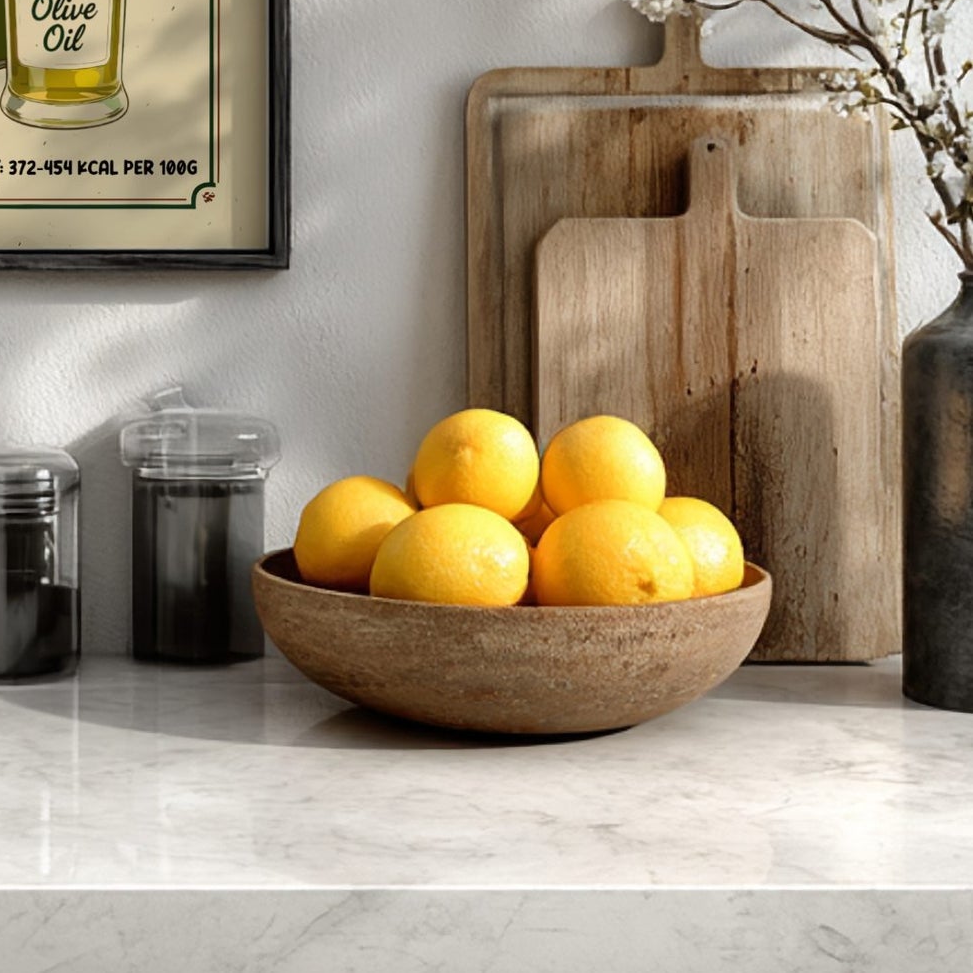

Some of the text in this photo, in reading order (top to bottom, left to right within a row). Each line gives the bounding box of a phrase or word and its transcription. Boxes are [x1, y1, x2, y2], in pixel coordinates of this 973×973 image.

[43, 23, 87, 52] Oil
[8, 159, 73, 176] 372-454
[123, 159, 155, 176] PER
[159, 159, 198, 176] 100G
